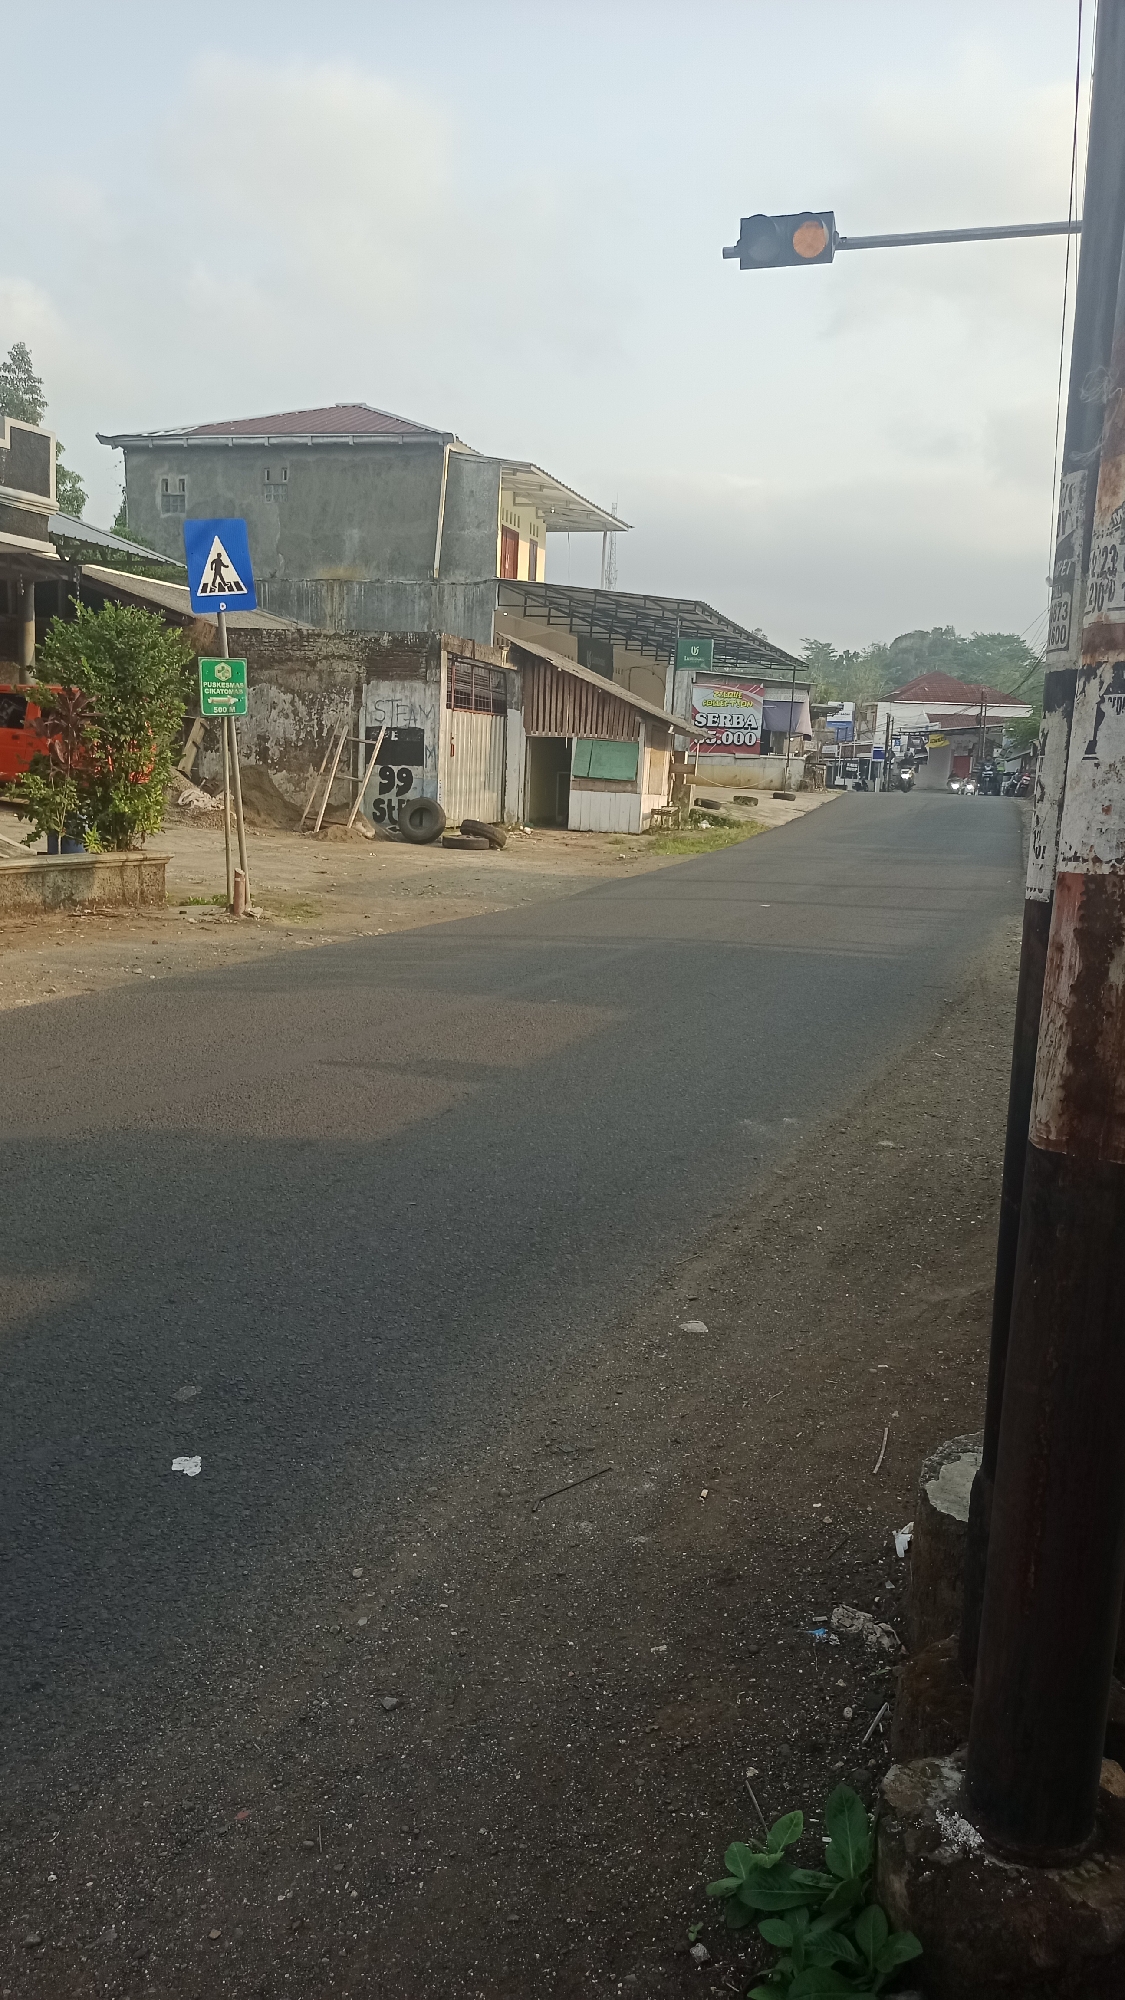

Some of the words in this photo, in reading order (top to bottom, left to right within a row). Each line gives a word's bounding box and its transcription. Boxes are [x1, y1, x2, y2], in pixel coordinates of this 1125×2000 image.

[694, 712, 759, 730] SERBA
[694, 731, 757, 746] 5.000
[378, 765, 414, 798] 99
